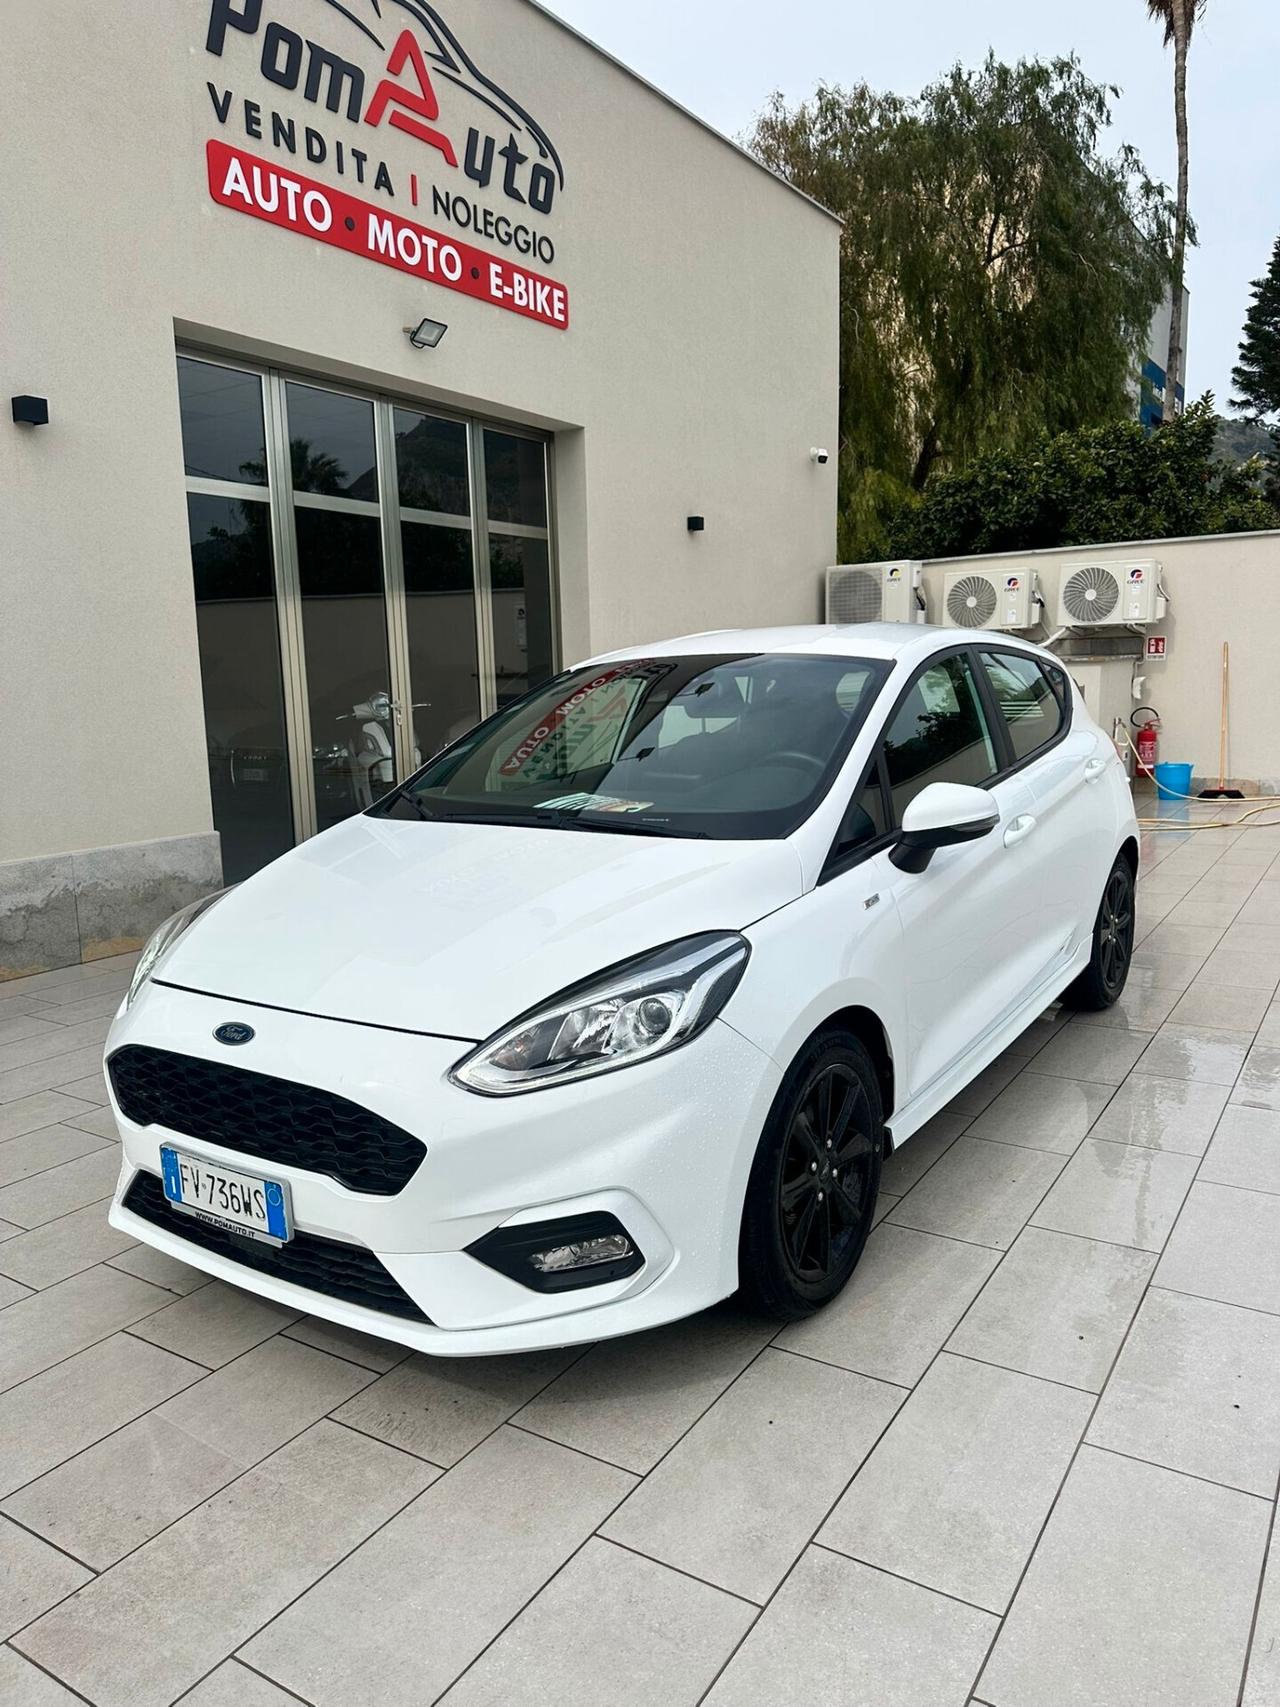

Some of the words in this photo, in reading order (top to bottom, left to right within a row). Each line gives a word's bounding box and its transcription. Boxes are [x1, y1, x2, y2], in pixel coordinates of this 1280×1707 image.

[207, 82, 394, 197] VENDITA
[432, 185, 555, 264] NOLEGGIO
[222, 157, 333, 232] AUTO
[368, 213, 462, 282] MOTO
[489, 262, 565, 322] E-BIKE
